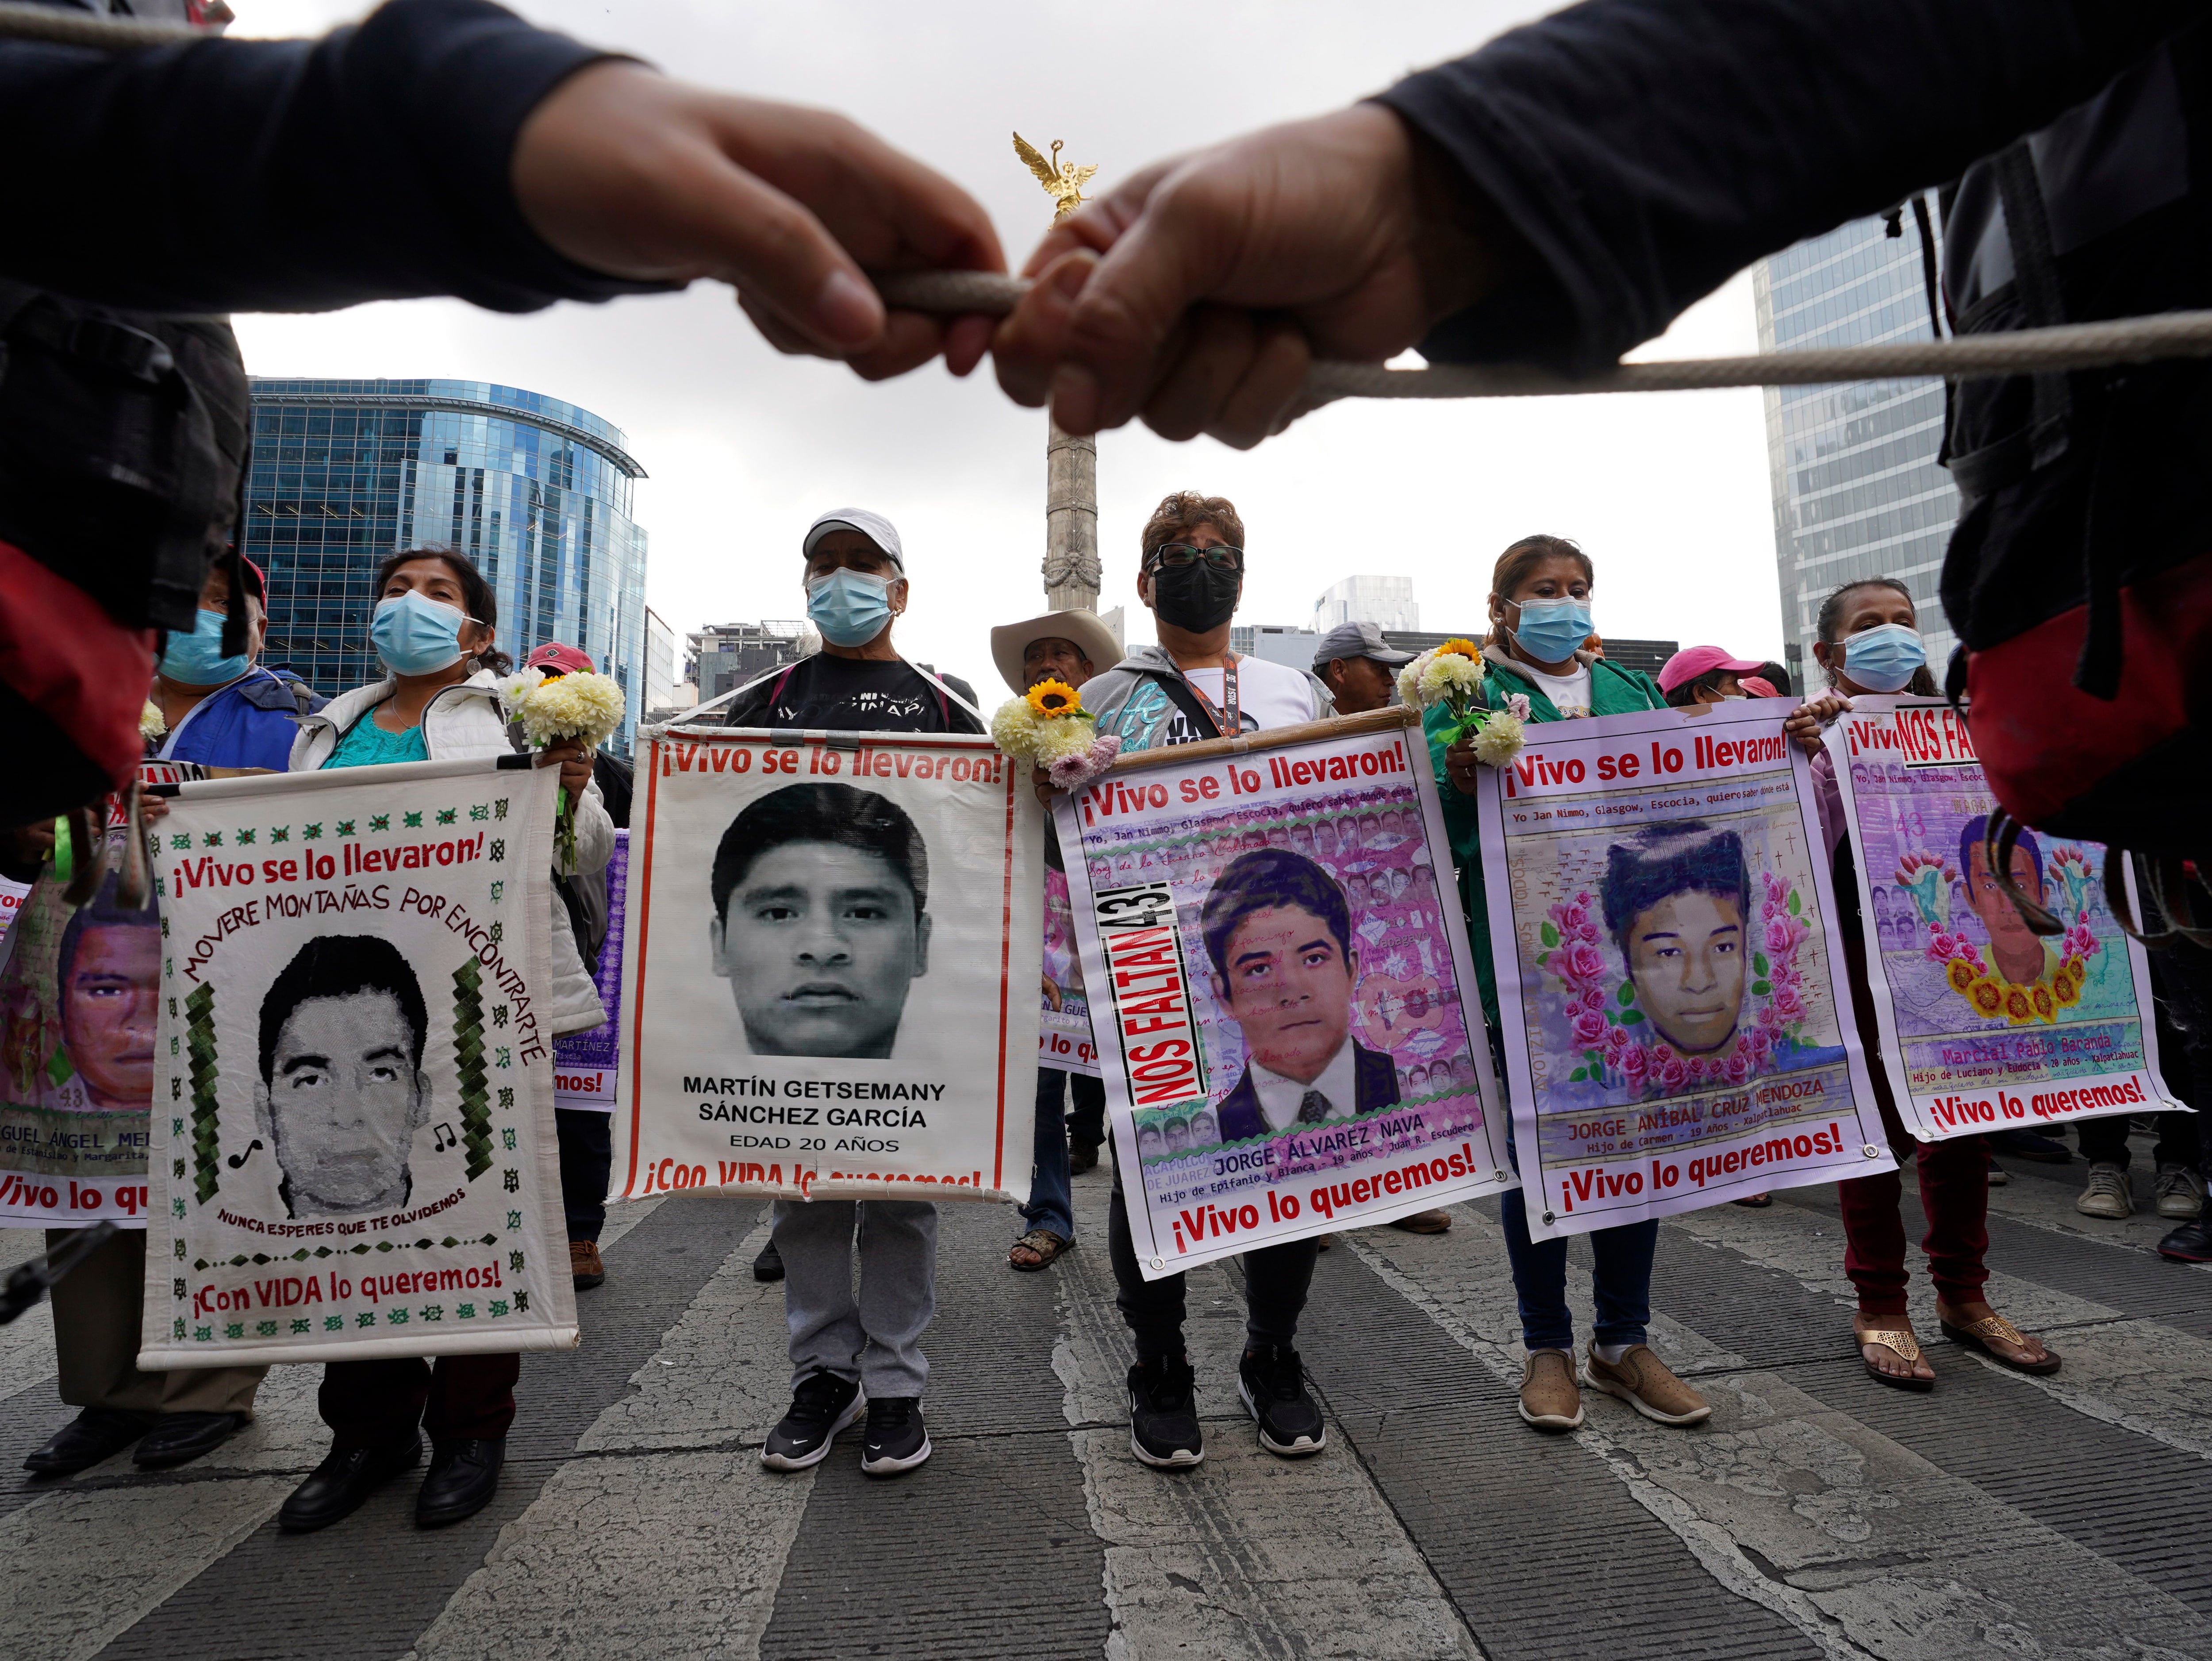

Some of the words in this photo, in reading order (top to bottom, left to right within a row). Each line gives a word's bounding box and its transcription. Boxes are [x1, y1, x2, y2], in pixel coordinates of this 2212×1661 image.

[1895, 709, 1942, 761] NOS
[662, 743, 752, 777] ¡Vivo
[762, 750, 799, 774] se
[810, 747, 841, 776] lo
[852, 747, 1002, 784] llevaron!
[1505, 754, 1585, 798] ¡Vivo
[1597, 753, 1640, 780] se
[1651, 742, 1684, 774] lo
[1694, 728, 1786, 769] llevaron!
[1960, 773, 1988, 781] Escoci
[1081, 781, 1169, 827] ¡Vivo
[1179, 776, 1220, 803] se
[1227, 765, 1261, 795] lo
[1268, 741, 1406, 788] llevaron!
[1513, 814, 1526, 822] Yo
[1533, 811, 1552, 820] Jan
[1556, 809, 1589, 818] Nimmo,
[1595, 804, 1644, 815] Glasgow,
[1651, 797, 1700, 810] Escocia,
[1707, 791, 1741, 804] quiero
[1743, 789, 1759, 798] saber
[1760, 785, 1774, 795] dónde
[1776, 782, 1790, 792] está
[1089, 835, 1107, 845] Yo,
[1114, 831, 1133, 841] Jan
[1139, 826, 1175, 838] Nimmo,
[1237, 807, 1283, 820] Escocia,
[1289, 801, 1323, 813] quiero
[1328, 796, 1355, 807] saber
[1361, 790, 1386, 802] dónde
[1896, 812, 1925, 837] 43
[174, 856, 254, 898] ¡Vivo
[262, 860, 297, 883] se
[305, 849, 335, 880] lo
[344, 831, 484, 876] llevaron!
[1119, 861, 1133, 871] de
[1373, 931, 1430, 949] Papagayo
[1518, 922, 1536, 973] SOMOS
[182, 900, 260, 983] MOVERE
[266, 884, 389, 919] MONTAÑAS
[399, 887, 446, 919] POR
[445, 904, 547, 1067] ENCONTRARTE
[1108, 926, 1187, 1037] FALTAN
[554, 1040, 610, 1052] MARTÍNEZ
[1051, 1033, 1071, 1054] lo
[1943, 1042, 2008, 1065] Marcial
[2016, 1039, 2055, 1057] Pablo
[2061, 1033, 2111, 1053] Baranda
[554, 1073, 603, 1092] mos!
[1128, 1038, 1198, 1105] NOS
[1913, 1073, 1936, 1084] Hijo
[1941, 1070, 1951, 1079] de
[1957, 1066, 1993, 1078] Luciano
[1997, 1066, 2003, 1076] y
[2008, 1062, 2041, 1073] Eudocia
[2051, 1059, 2059, 1068] 20
[2063, 1057, 2080, 1066] años
[2092, 1050, 2139, 1063] Xalpatlahuac
[59, 1088, 84, 1107] 43
[684, 1075, 775, 1097] MARTÍN
[784, 1080, 945, 1101] GETSEMANY
[1930, 1096, 1995, 1133] ¡Vivo
[1998, 1091, 2024, 1119] lo
[2032, 1075, 2147, 1120] queremos!
[699, 1100, 819, 1125] SÁNCHEZ
[827, 1106, 926, 1128] GARCÍA
[1568, 1119, 1626, 1140] JORGE
[1638, 1107, 1701, 1132] ANÍBAL
[1712, 1097, 1750, 1119] CRUZ
[1755, 1079, 1824, 1106] MENDOZA
[1587, 1142, 1614, 1153] Hijo
[1620, 1140, 1634, 1149] de
[1639, 1133, 1674, 1146] Carmen
[1690, 1128, 1701, 1137] 19
[1706, 1123, 1728, 1134] Años
[1743, 1103, 1802, 1126] Xalpatlahuac
[0, 1125, 40, 1144] GUEL
[50, 1128, 104, 1148] ÁNGEL
[21, 1146, 68, 1161] Estanislao
[84, 1152, 149, 1162] Margarita,
[730, 1135, 791, 1149] EDAD
[799, 1138, 826, 1150] 20
[834, 1136, 899, 1152] AÑOS
[1214, 1148, 1275, 1176] JORGE
[1288, 1127, 1371, 1160] ÁLVAREZ
[1380, 1114, 1425, 1138] NAVA
[643, 1158, 707, 1193] ¡Con
[718, 1161, 783, 1187] VIDA
[1144, 1154, 1206, 1176] ACAPULCO
[1147, 1179, 1162, 1190] DE
[1165, 1167, 1210, 1187] JUÁREZ
[1160, 1191, 1186, 1203] Hijo
[1192, 1186, 1205, 1196] de
[1210, 1175, 1261, 1192] Epifanio
[1266, 1172, 1272, 1182] y
[1278, 1162, 1315, 1177] Blanca
[1332, 1154, 1344, 1164] 19
[1350, 1150, 1374, 1161] años
[1389, 1140, 1411, 1150] Juan
[1415, 1135, 1426, 1144] R.
[1431, 1123, 1474, 1140] Escudero
[1562, 1168, 1643, 1212] ¡Vivo
[1652, 1160, 1679, 1190] lo
[1688, 1123, 1844, 1187] queremos!
[69, 1181, 102, 1209] lo
[217, 1208, 265, 1234] NUNCA
[267, 1222, 334, 1238] ESPERES
[338, 1220, 367, 1236] QUE
[370, 1216, 389, 1230] TE
[391, 1188, 466, 1227] OLVIDEMOS
[1172, 1203, 1260, 1254] ¡Vivo
[1267, 1190, 1300, 1223] lo
[1310, 1143, 1476, 1219] queremos!
[193, 1284, 250, 1320] ¡Con
[254, 1276, 323, 1307] VIDA
[330, 1271, 352, 1301] lo
[361, 1260, 503, 1304] queremos!
